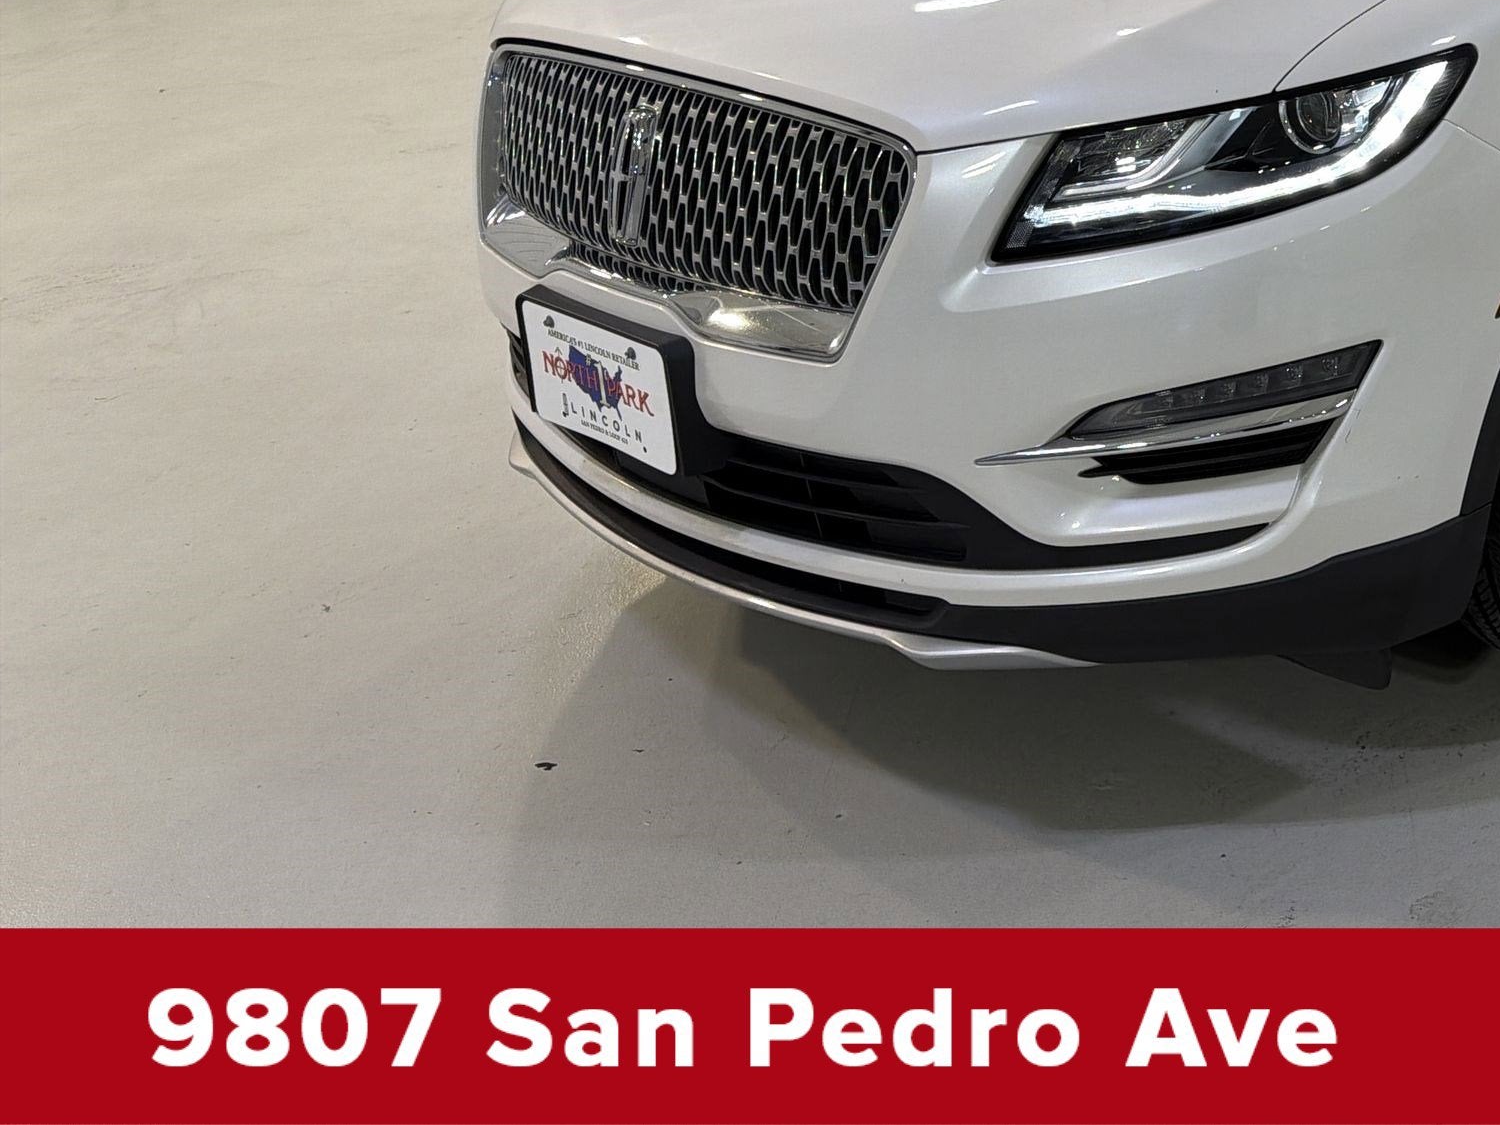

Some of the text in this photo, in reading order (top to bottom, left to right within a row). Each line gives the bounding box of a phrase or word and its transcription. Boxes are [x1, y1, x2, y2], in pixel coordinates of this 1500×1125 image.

[584, 341, 611, 359] LINCOLN
[611, 352, 640, 371] RETAILER
[542, 350, 655, 417] NORTH PARK
[570, 402, 643, 443] LINCOLN
